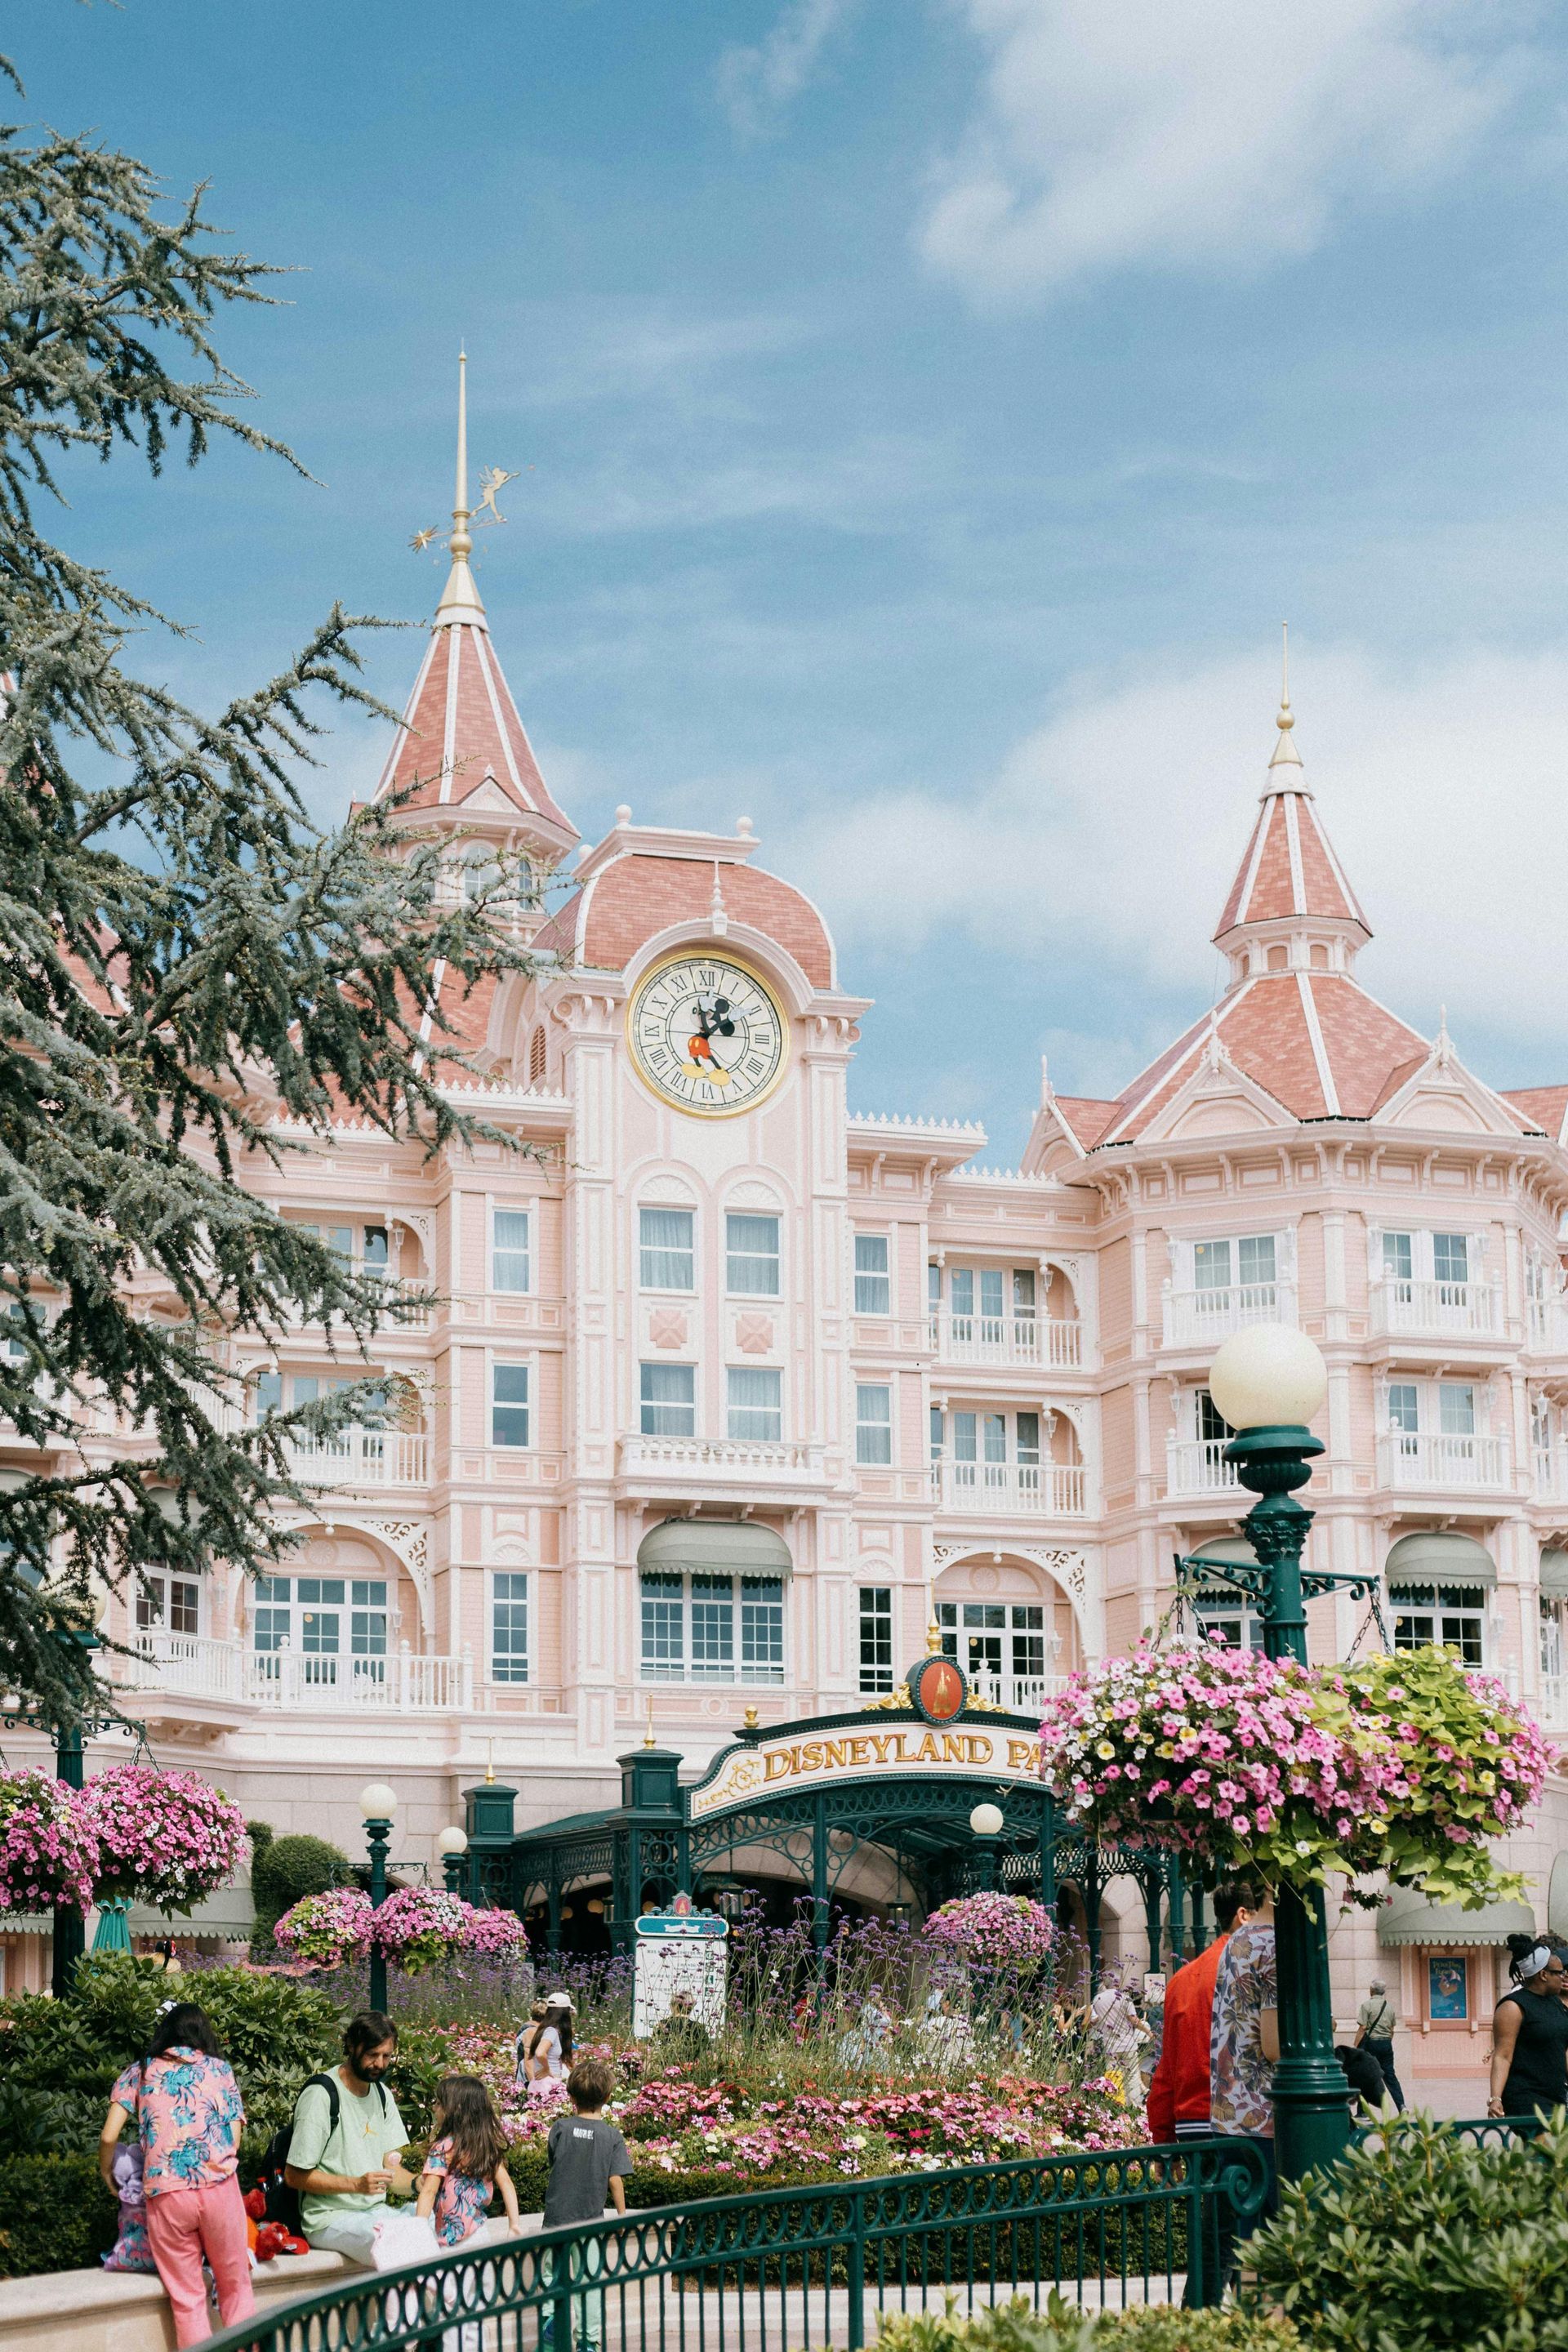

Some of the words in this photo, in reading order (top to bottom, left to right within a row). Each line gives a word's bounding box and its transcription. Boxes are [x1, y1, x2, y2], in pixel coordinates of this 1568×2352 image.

[670, 974, 688, 993] XI
[699, 970, 715, 987] XII
[730, 982, 739, 996] I
[652, 996, 668, 1010] X
[749, 1004, 762, 1016] II
[644, 1025, 660, 1037] IX
[755, 1034, 769, 1045] III
[649, 1049, 669, 1071] VIII
[746, 1058, 764, 1076] IIII
[670, 1071, 688, 1092] VII
[732, 1078, 743, 1094] V
[702, 1083, 715, 1099] VI
[764, 1733, 994, 1783] DISNEYLAND
